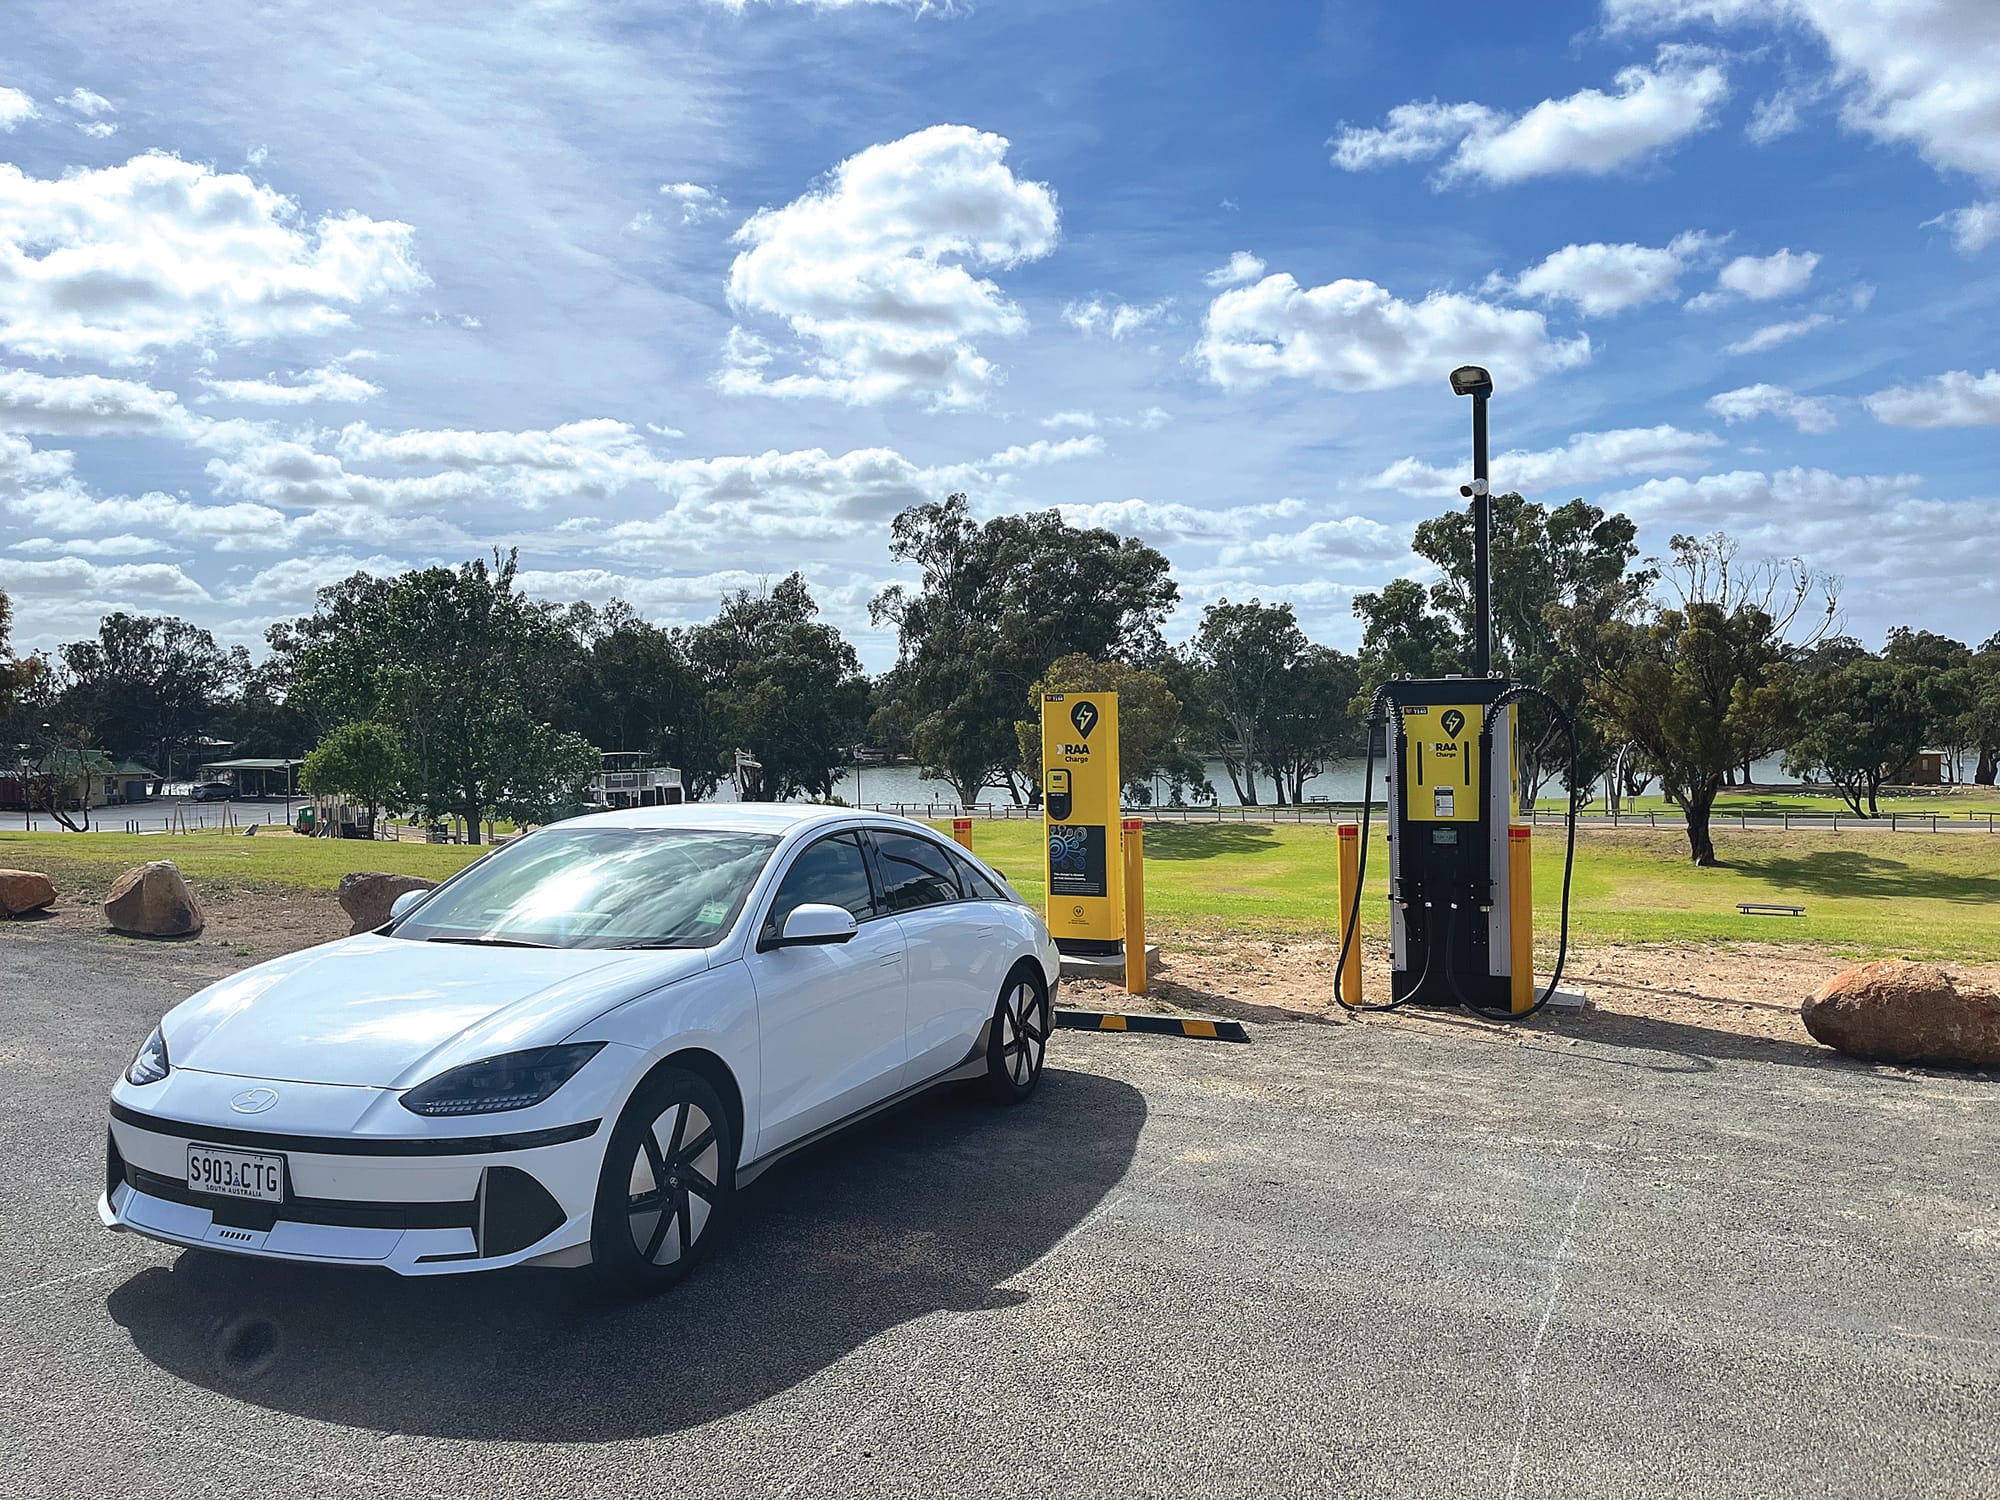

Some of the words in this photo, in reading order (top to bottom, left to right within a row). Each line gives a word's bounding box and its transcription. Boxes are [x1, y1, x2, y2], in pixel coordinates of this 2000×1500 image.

[1065, 744, 1090, 755] RAA
[1436, 742, 1458, 751] RAA
[206, 1184, 226, 1193] SOUTH
[228, 1185, 262, 1197] AUSTRALIA
